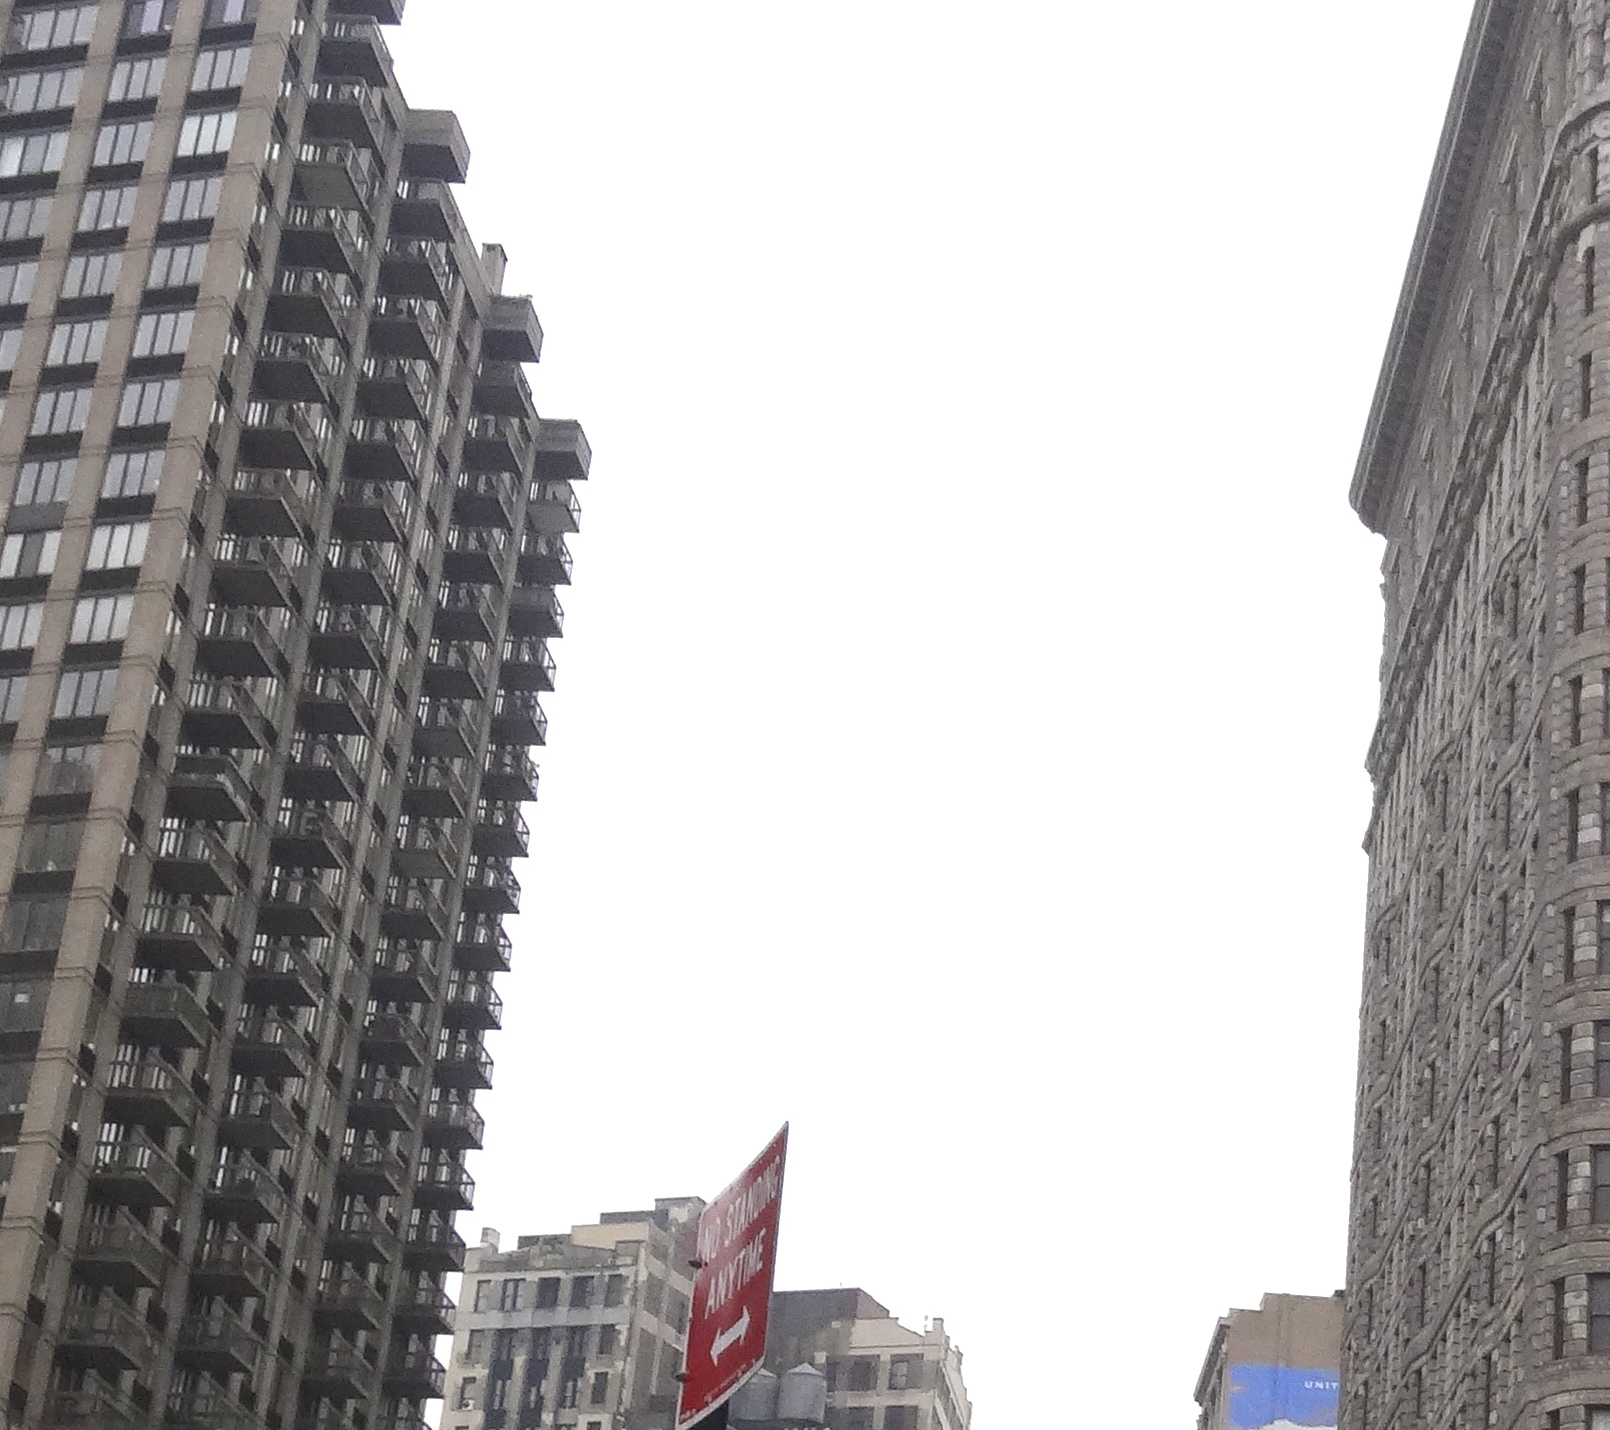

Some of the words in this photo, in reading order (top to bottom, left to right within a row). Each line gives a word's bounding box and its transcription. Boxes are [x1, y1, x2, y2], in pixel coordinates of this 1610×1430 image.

[701, 1216, 721, 1262] NO
[724, 1154, 781, 1249] STANDING
[704, 1227, 767, 1321] ANYTIME
